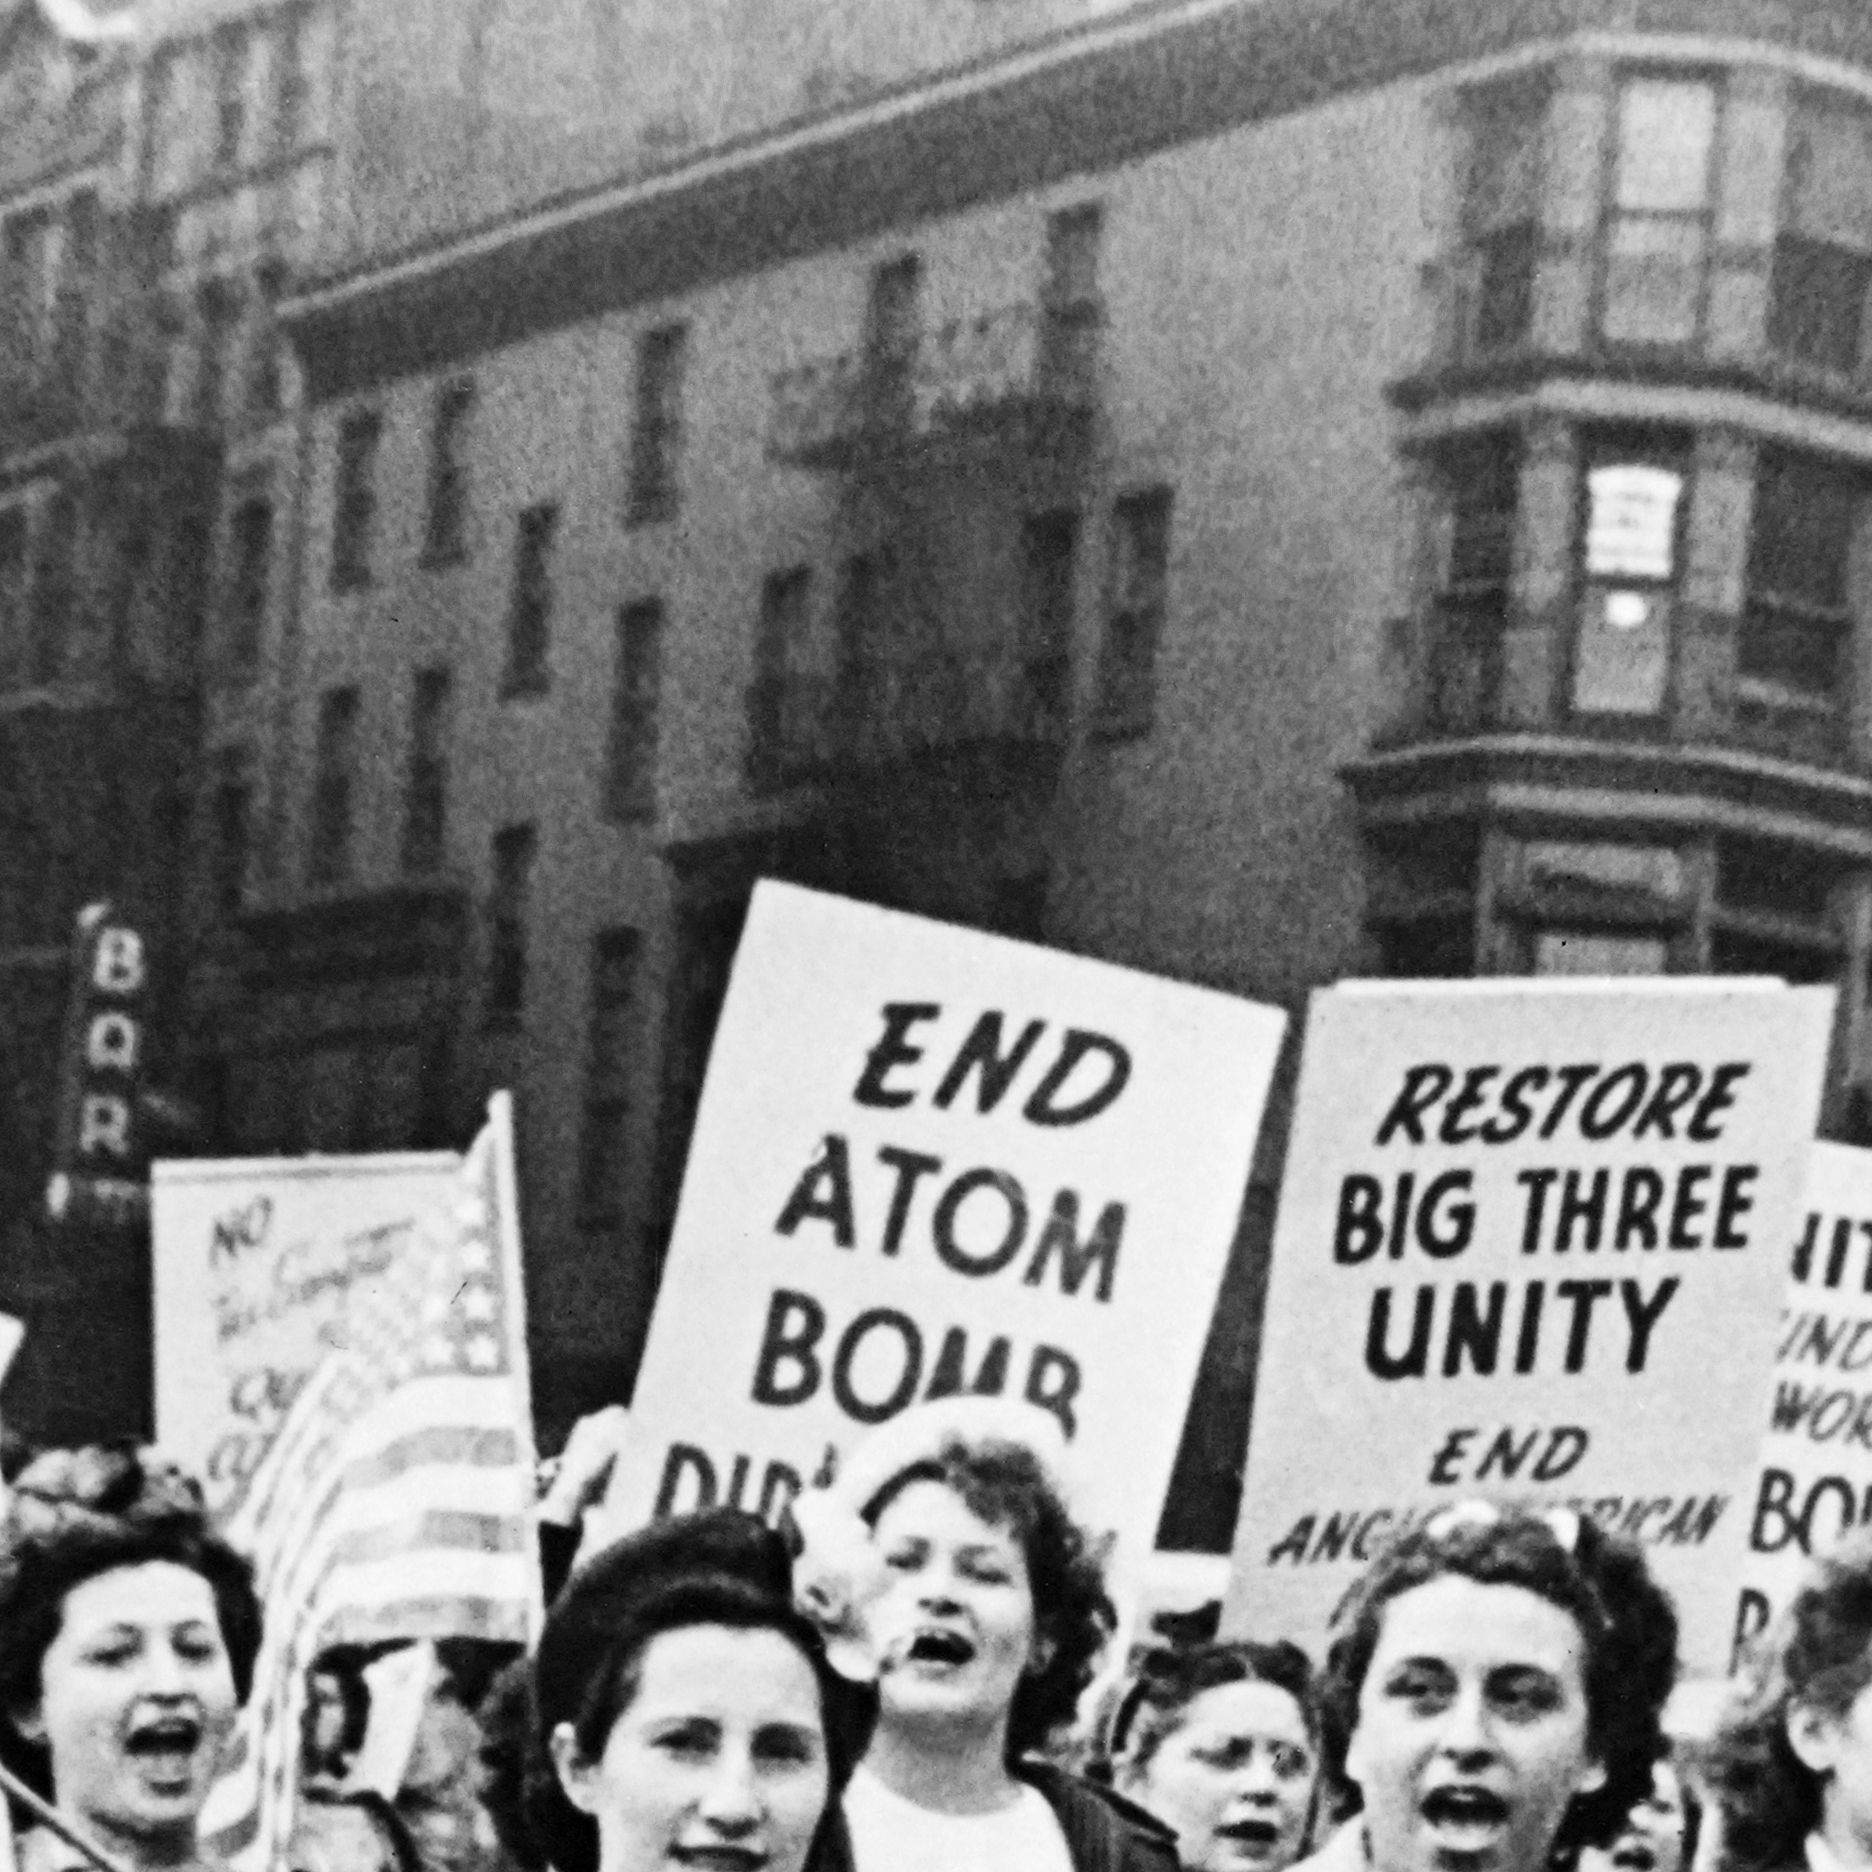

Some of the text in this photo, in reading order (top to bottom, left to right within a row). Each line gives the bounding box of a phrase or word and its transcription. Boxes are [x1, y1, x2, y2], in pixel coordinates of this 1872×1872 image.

[852, 1001, 1132, 1127] END
[1374, 1061, 1756, 1148] RESTORE
[773, 1132, 1127, 1303] ATOM
[1332, 1163, 1761, 1266] BIG THREE
[750, 1287, 1083, 1441] BOMB
[1364, 1276, 1681, 1382] UNITY
[1428, 1425, 1590, 1487] END
